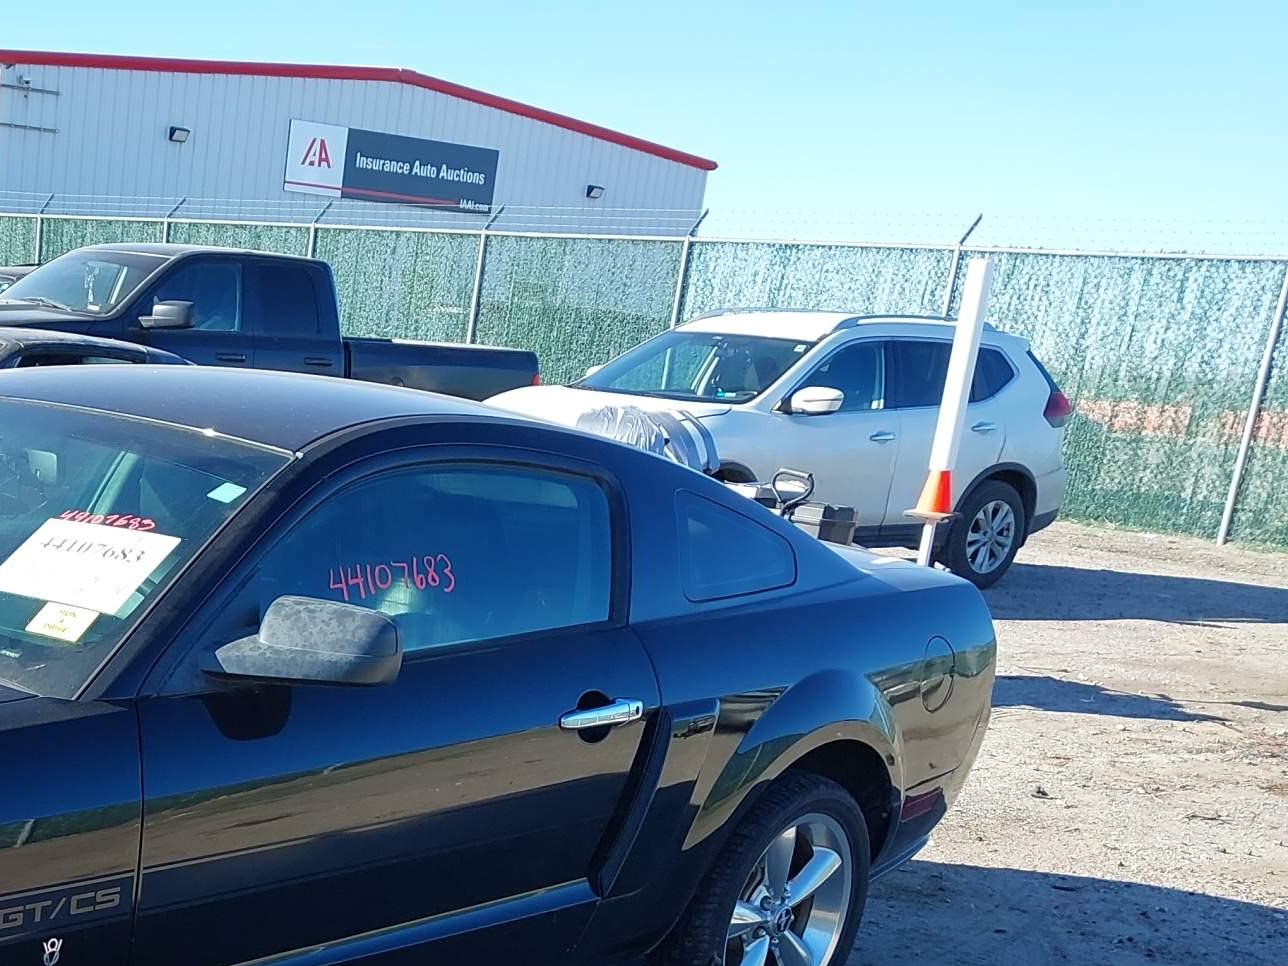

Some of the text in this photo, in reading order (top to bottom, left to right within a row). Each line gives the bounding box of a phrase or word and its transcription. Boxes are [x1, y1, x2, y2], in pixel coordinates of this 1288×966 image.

[355, 151, 486, 185] Insurance Auto Auctions
[60, 510, 156, 531] 44107683
[328, 554, 456, 601] 44107683
